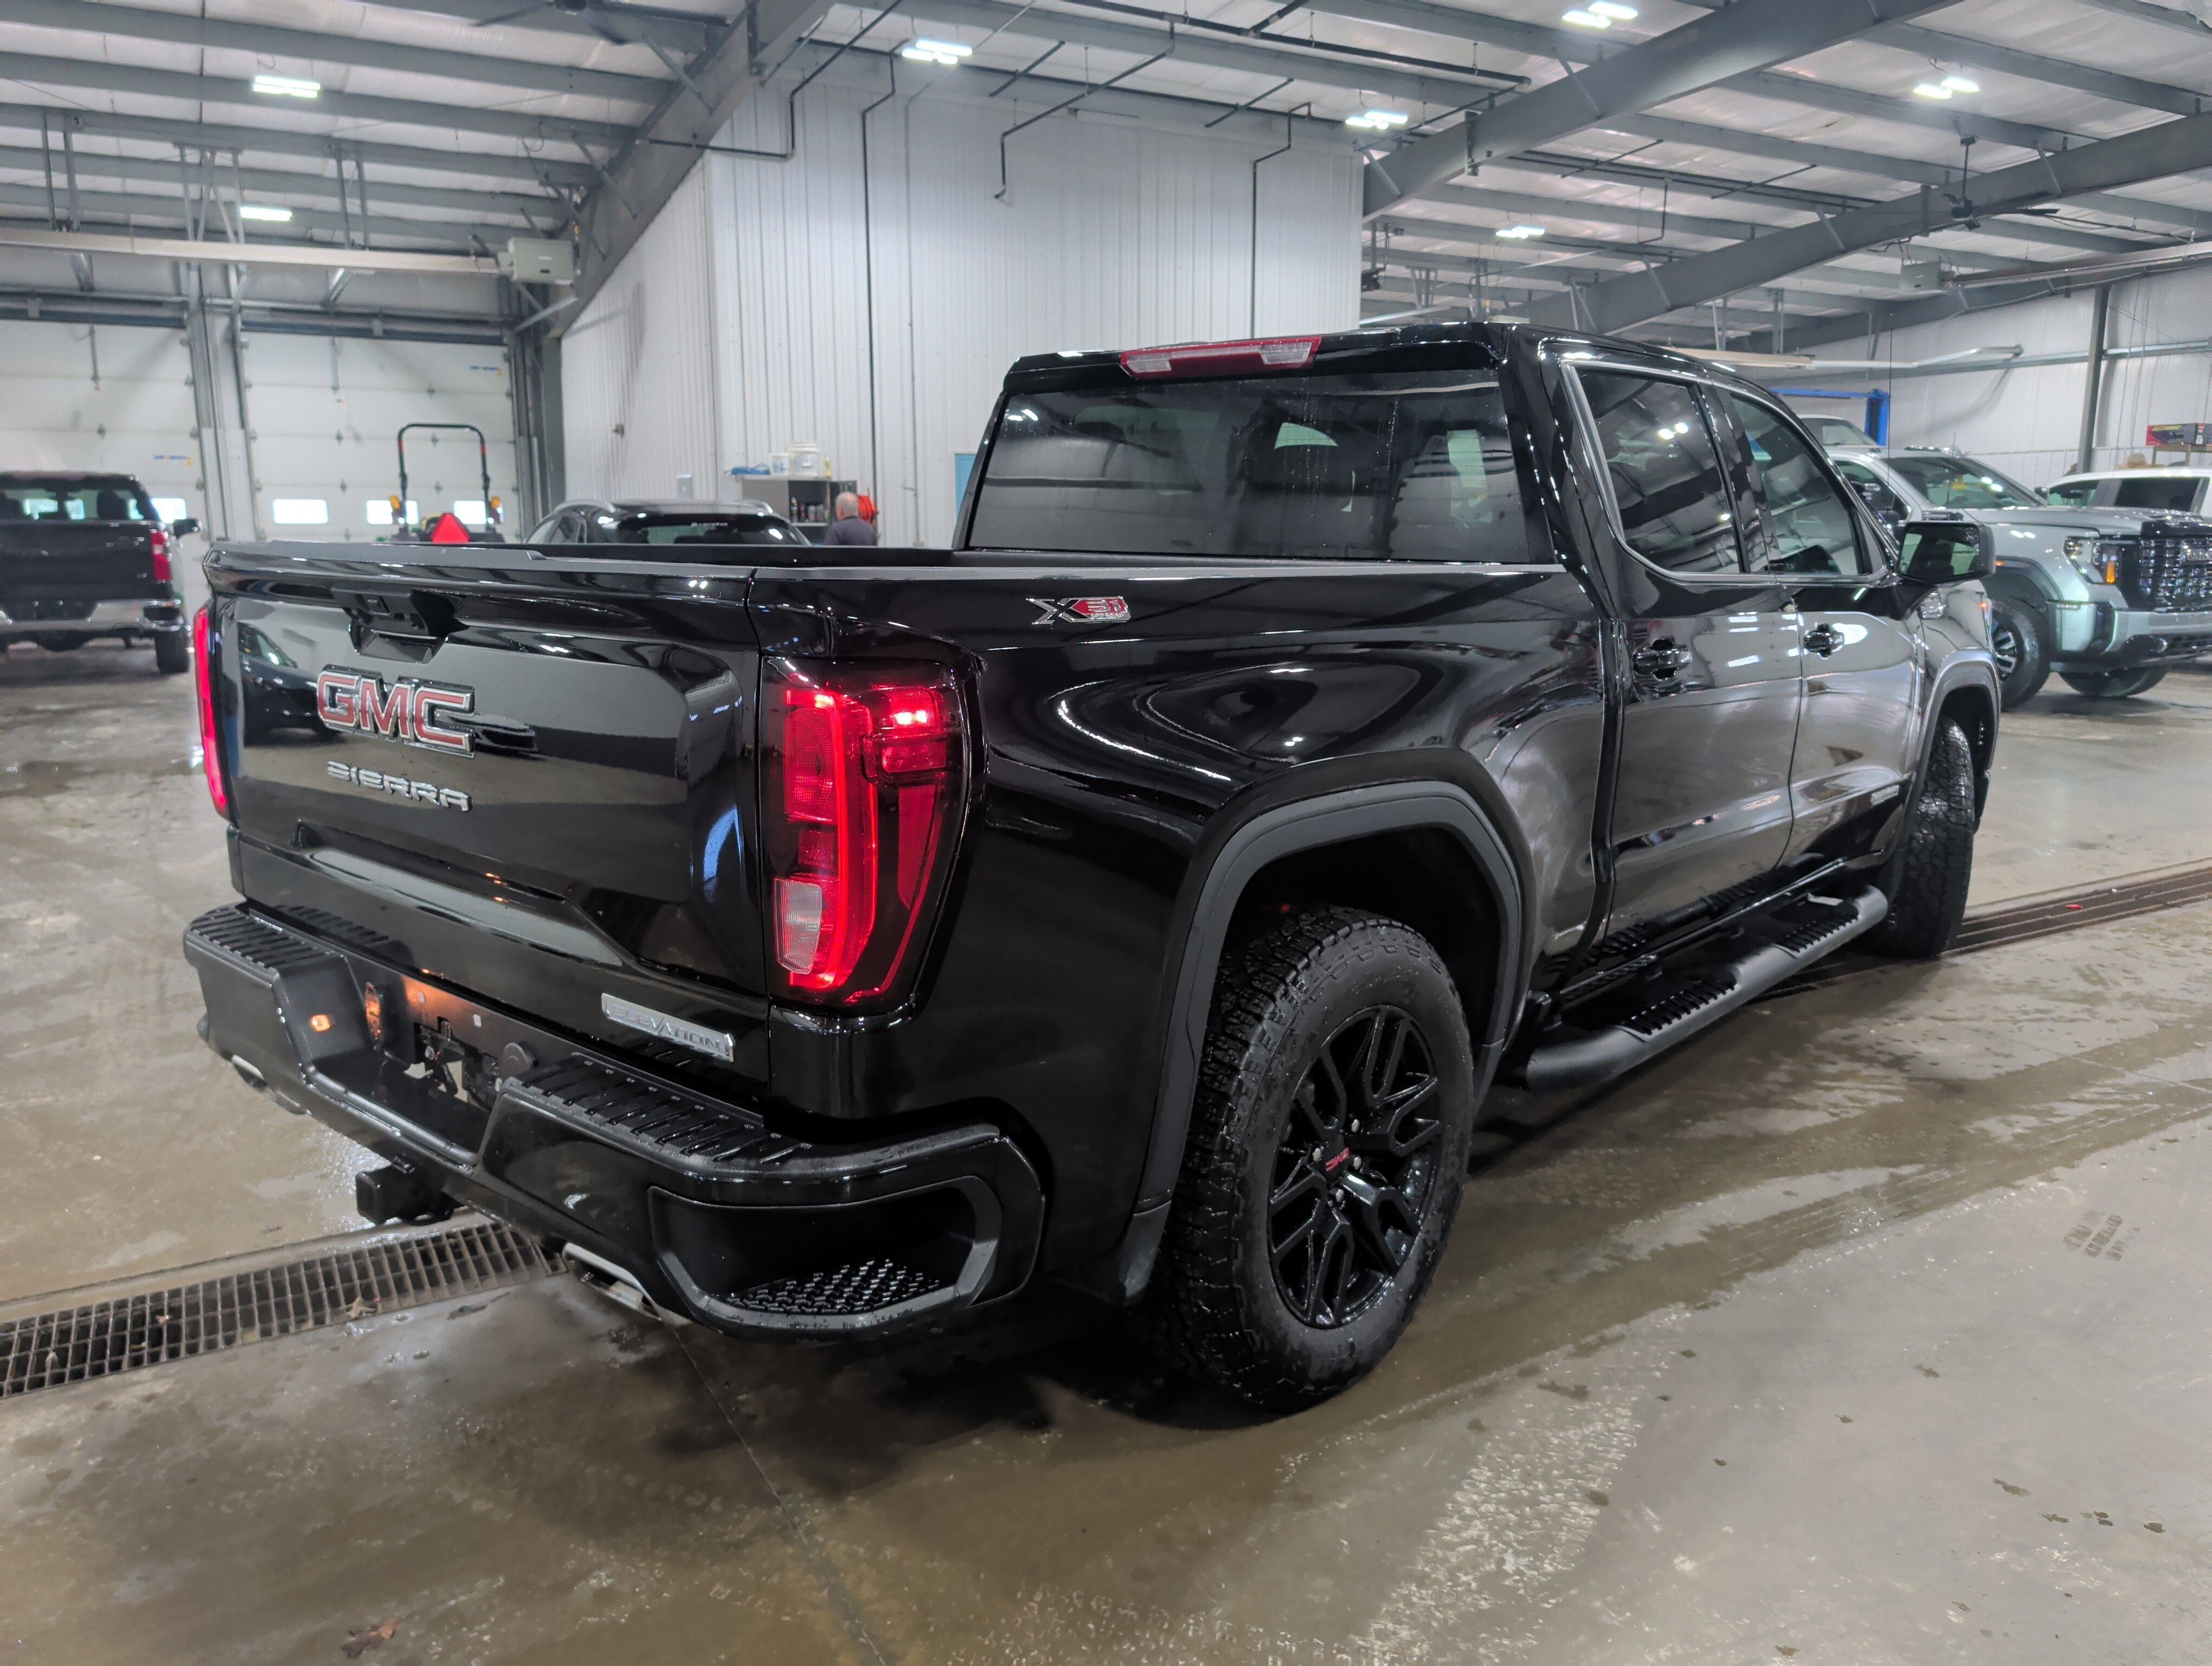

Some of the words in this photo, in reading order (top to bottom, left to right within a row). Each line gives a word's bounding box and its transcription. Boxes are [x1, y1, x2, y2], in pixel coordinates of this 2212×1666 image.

[317, 666, 475, 755] GMC
[327, 760, 473, 812] SIERRA
[613, 1004, 722, 1053] ELEVATION
